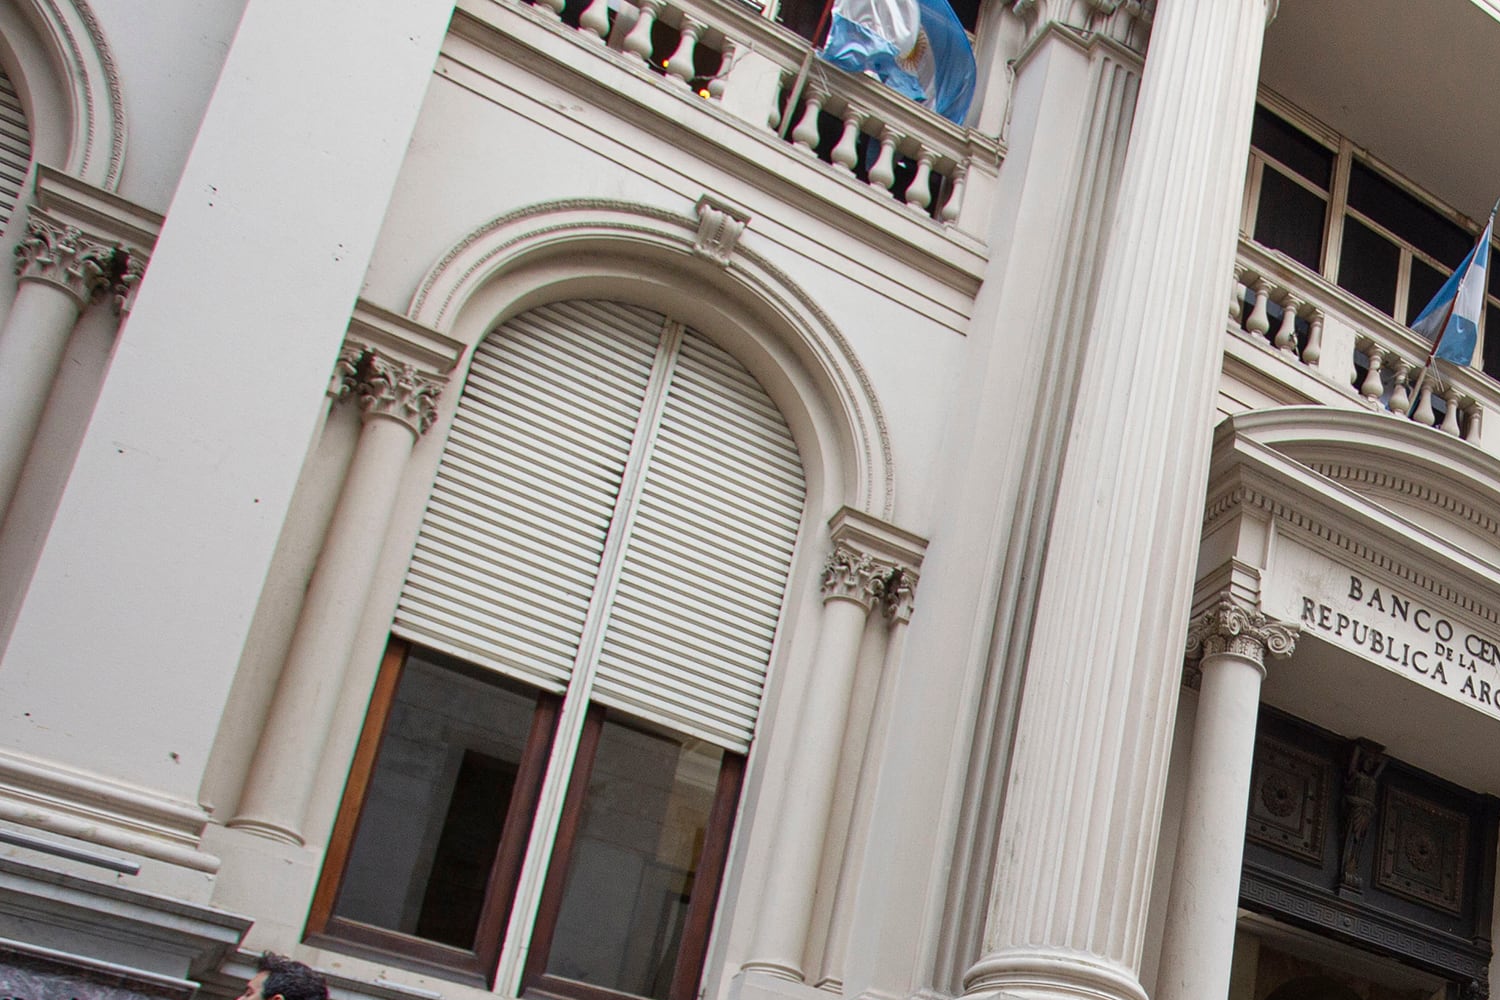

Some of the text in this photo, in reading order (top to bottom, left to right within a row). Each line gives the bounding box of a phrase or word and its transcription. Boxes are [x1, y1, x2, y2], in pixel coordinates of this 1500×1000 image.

[1300, 596, 1448, 685] REPUBLICA
[1348, 575, 1454, 642] BANCO
[1435, 642, 1479, 673] DE LA
